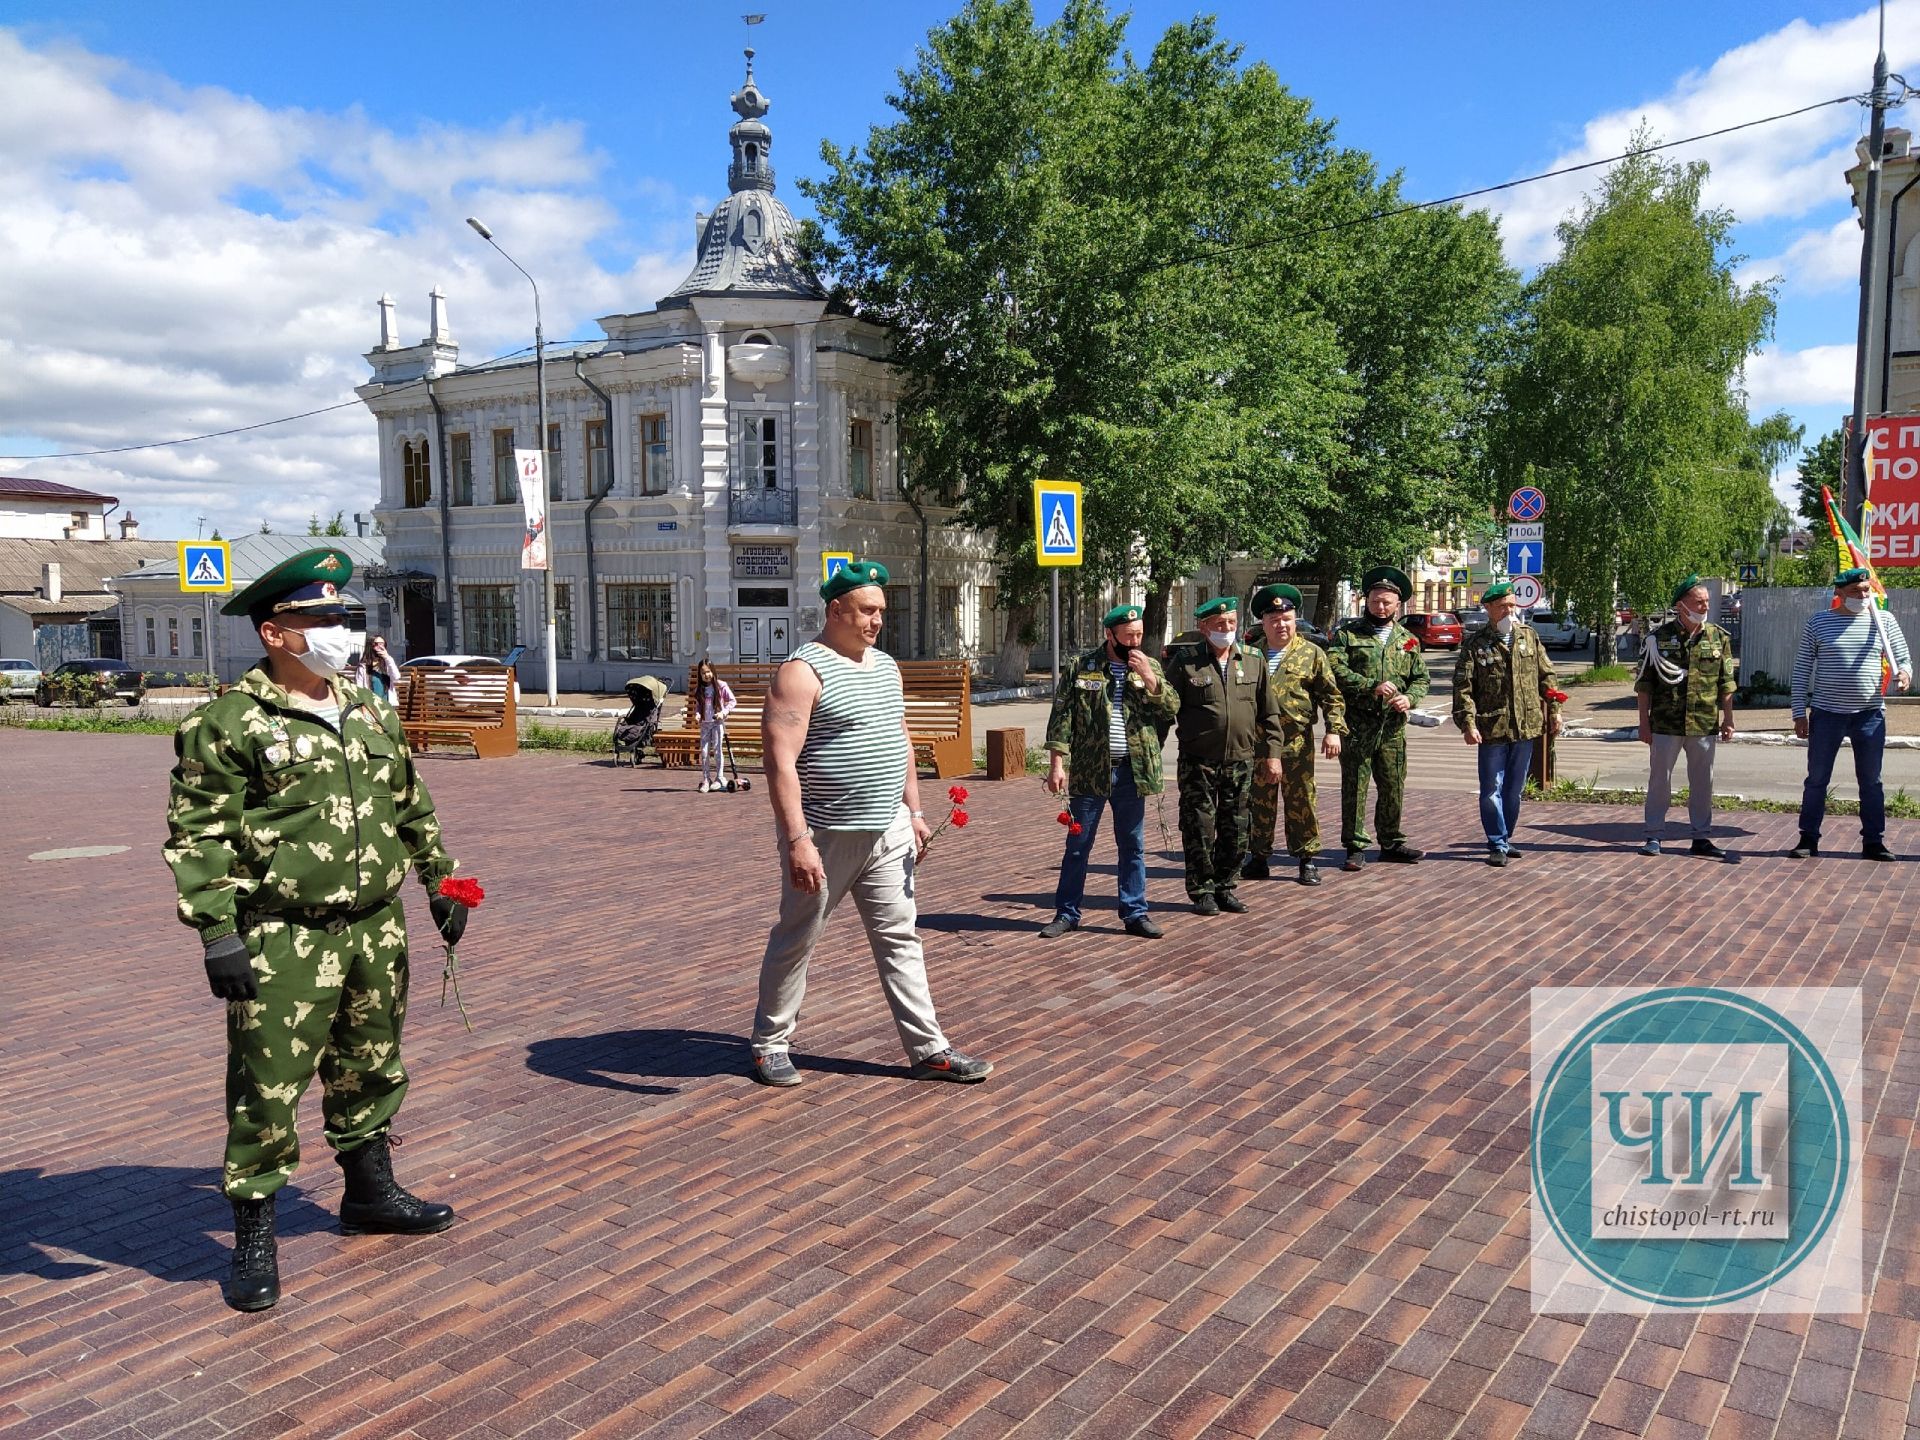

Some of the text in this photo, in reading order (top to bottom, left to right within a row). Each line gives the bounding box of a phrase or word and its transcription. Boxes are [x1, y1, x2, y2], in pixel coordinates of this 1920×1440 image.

[1872, 427, 1889, 450] С
[1871, 457, 1918, 480] ПО
[736, 556, 789, 566] СУВЕНИРНЫЙ
[745, 566, 780, 575] САЛОНЪ
[1514, 585, 1534, 598] 40
